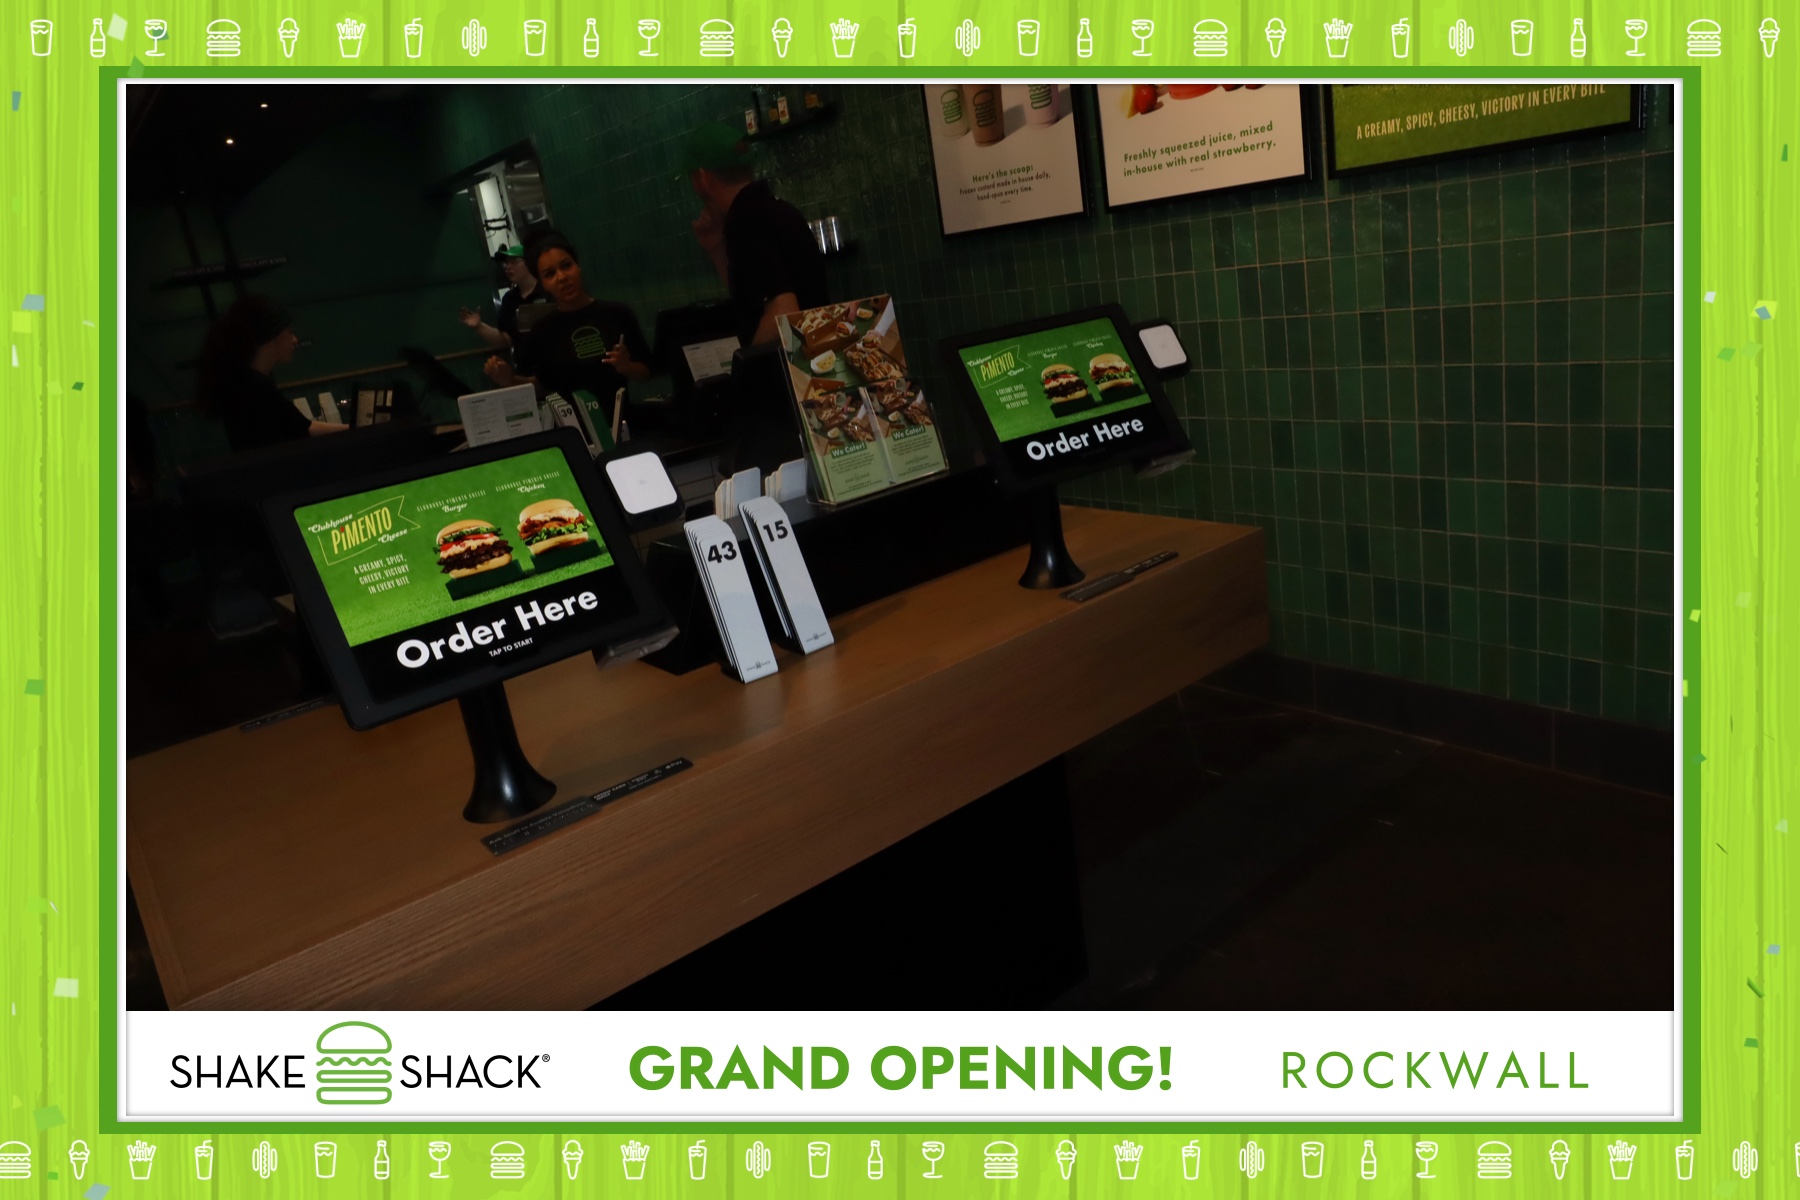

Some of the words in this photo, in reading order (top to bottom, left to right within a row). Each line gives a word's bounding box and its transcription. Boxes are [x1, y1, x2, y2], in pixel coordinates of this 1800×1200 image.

[1356, 125, 1364, 140] A
[1364, 116, 1404, 138] CREAMY,
[1406, 111, 1437, 130] SPICY,
[1438, 102, 1479, 124] CHEESY,
[1481, 93, 1524, 116] VICTORY
[1527, 90, 1540, 108] IN
[1542, 85, 1576, 105] EVERY
[1580, 84, 1606, 98] BITE
[1124, 148, 1157, 163] Freshly
[1160, 136, 1206, 156] squeezed
[1208, 132, 1237, 147] juice,
[1240, 120, 1273, 138] mixed
[1124, 162, 1163, 177] in-house
[1166, 156, 1187, 168] with
[1190, 150, 1210, 164] real
[1213, 140, 1276, 159] strawberry.
[972, 172, 994, 182] Here's
[996, 168, 1008, 178] the
[1010, 165, 1034, 176] scoop:
[560, 408, 573, 418] 39
[586, 401, 598, 410] 70
[1026, 430, 1090, 462] Order
[1092, 418, 1144, 443] Here
[832, 448, 844, 457] We
[442, 503, 468, 513] Burger
[308, 514, 353, 533] Clubhouse
[762, 520, 788, 542] 15
[378, 529, 408, 543] Cheese
[708, 541, 737, 564] 43
[354, 566, 360, 575] A
[358, 559, 386, 574] CREAMY,
[386, 554, 406, 566] SPICY,
[384, 564, 410, 578] VICTORY
[368, 586, 376, 594] IN
[377, 580, 396, 592] EVERY
[396, 576, 410, 587] BITE
[396, 618, 508, 668] Order
[514, 591, 598, 632] Here
[488, 646, 502, 658] TAP
[503, 644, 513, 654] TO
[513, 637, 534, 650] START
